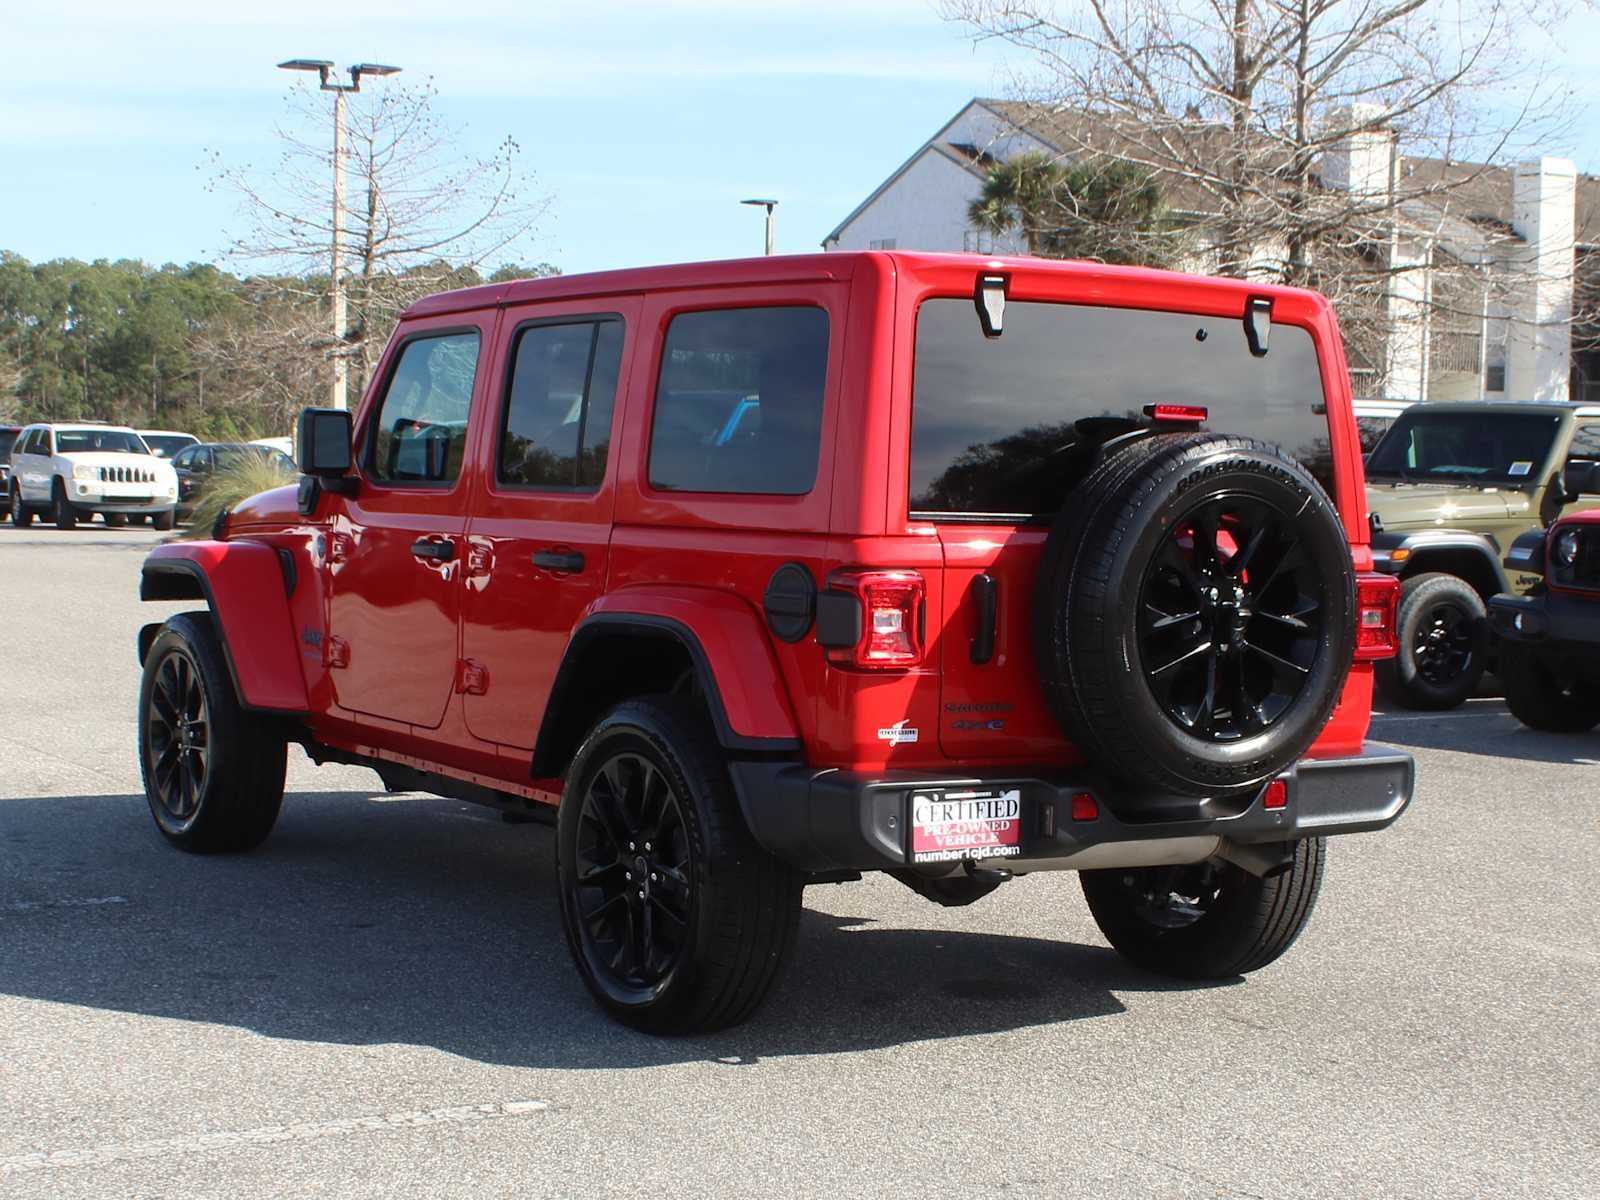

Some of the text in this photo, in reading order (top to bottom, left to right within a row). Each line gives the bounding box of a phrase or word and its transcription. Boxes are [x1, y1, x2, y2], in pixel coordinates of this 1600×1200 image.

[915, 799, 1018, 823] CERTIFIED
[923, 820, 1010, 837] PRE-OWNED
[935, 832, 1000, 846] VEHICLE
[914, 846, 1020, 862] number1cjd.com
